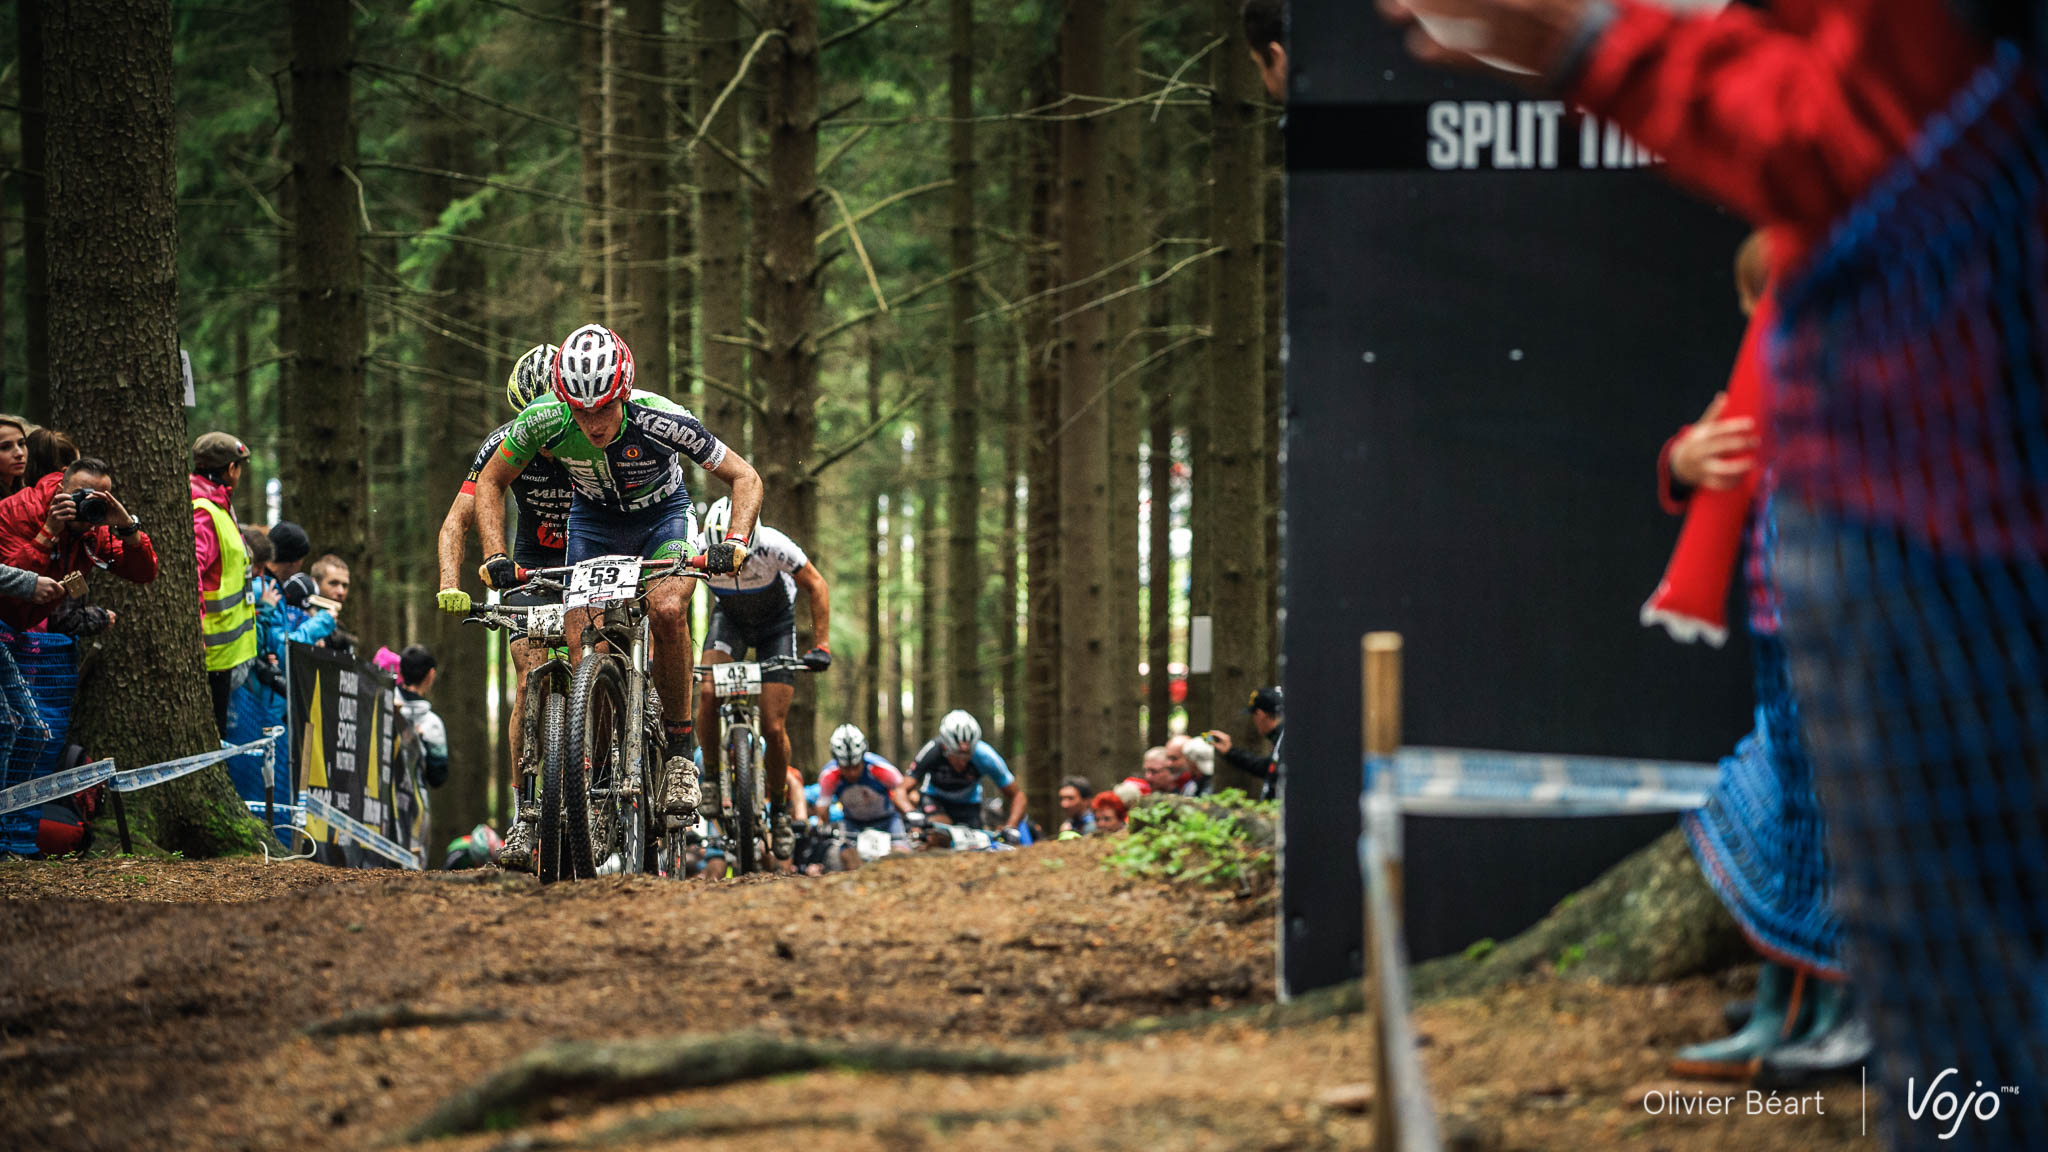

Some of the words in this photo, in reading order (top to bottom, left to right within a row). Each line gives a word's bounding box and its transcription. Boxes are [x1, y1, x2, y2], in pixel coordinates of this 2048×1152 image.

[1427, 101, 1566, 169] SPLIT
[1575, 104, 1667, 169] TI
[474, 426, 511, 465] TREK
[635, 410, 706, 455] KENDA
[589, 567, 620, 587] 53
[727, 665, 747, 681] 43
